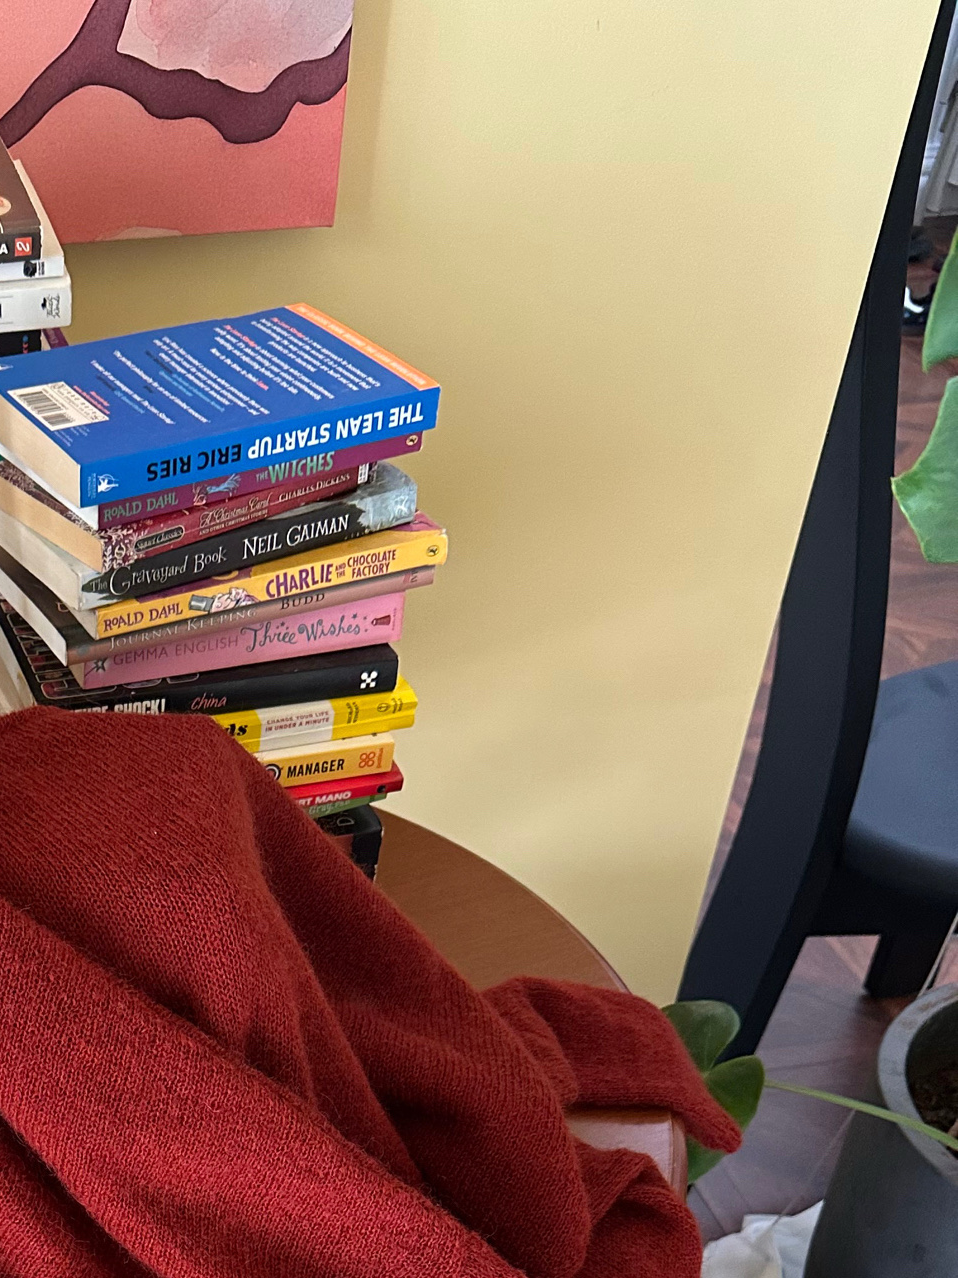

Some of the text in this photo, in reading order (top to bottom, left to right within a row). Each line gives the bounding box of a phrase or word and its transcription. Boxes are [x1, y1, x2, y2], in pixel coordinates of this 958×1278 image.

[146, 401, 424, 482] THE LEAN STARTUP ERIC RIES
[103, 451, 336, 522] ROALD DAHL THE WITCHES
[278, 485, 315, 503] CHARLES
[315, 473, 351, 491] DICKENS
[90, 514, 350, 598] The Graveyard Book NEIL GAIMAN
[346, 548, 397, 568] CHOCOLATE
[350, 560, 391, 577] FACTORY
[103, 562, 346, 633] ROALD DAHL CHARLIE AND
[109, 592, 327, 650] JOURNAL KEEPING BUDD
[112, 615, 363, 665] GEMMA ENGLISH Three Wishes
[190, 692, 228, 711] china
[274, 716, 330, 731] UNDER MINUTE
[286, 758, 345, 779] MANAGER
